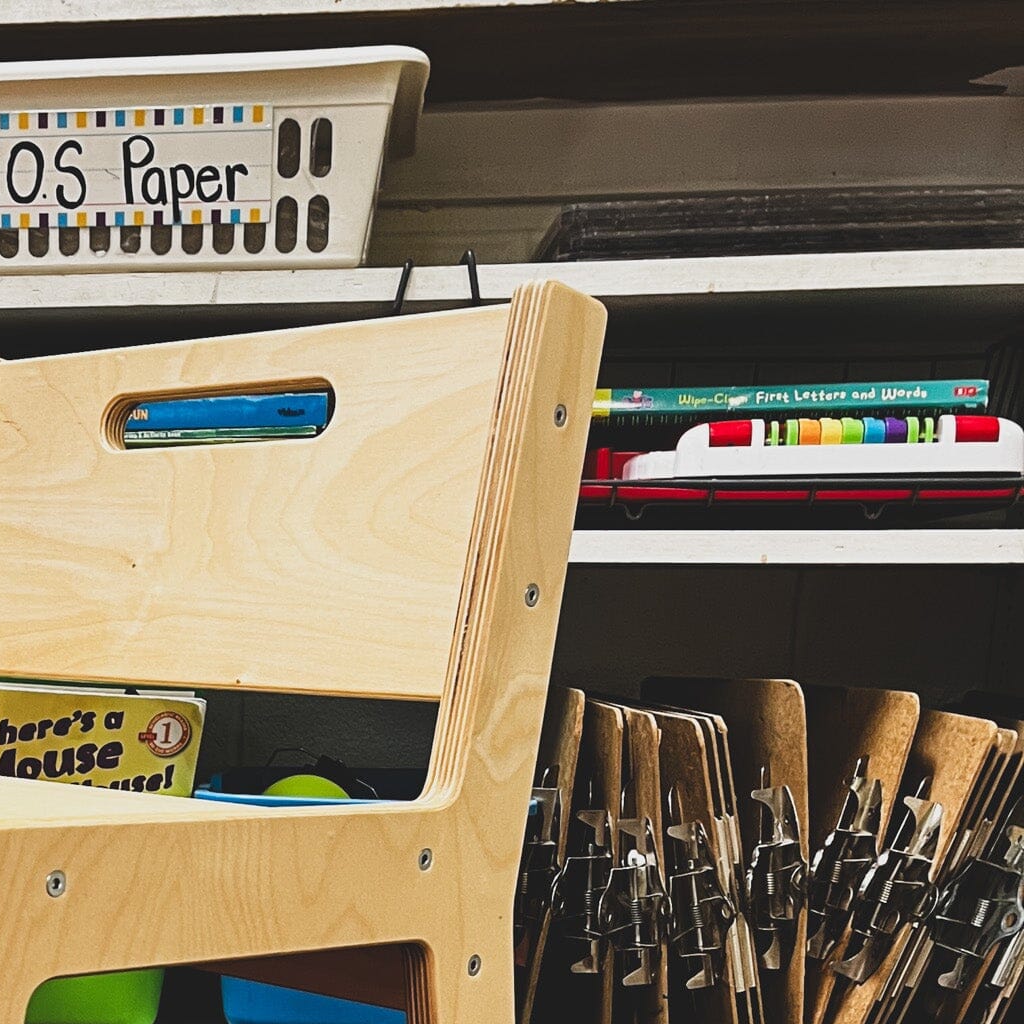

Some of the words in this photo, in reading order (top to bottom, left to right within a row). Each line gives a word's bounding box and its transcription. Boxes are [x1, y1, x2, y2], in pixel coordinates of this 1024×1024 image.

[122, 135, 249, 224] Paper
[678, 392, 748, 408] Wipe-Cl
[756, 390, 789, 404] First
[794, 389, 847, 401] Letters
[851, 387, 876, 400] and
[881, 386, 928, 400] Words
[104, 711, 124, 729] a
[160, 721, 172, 744] 1
[71, 765, 175, 793] use!
